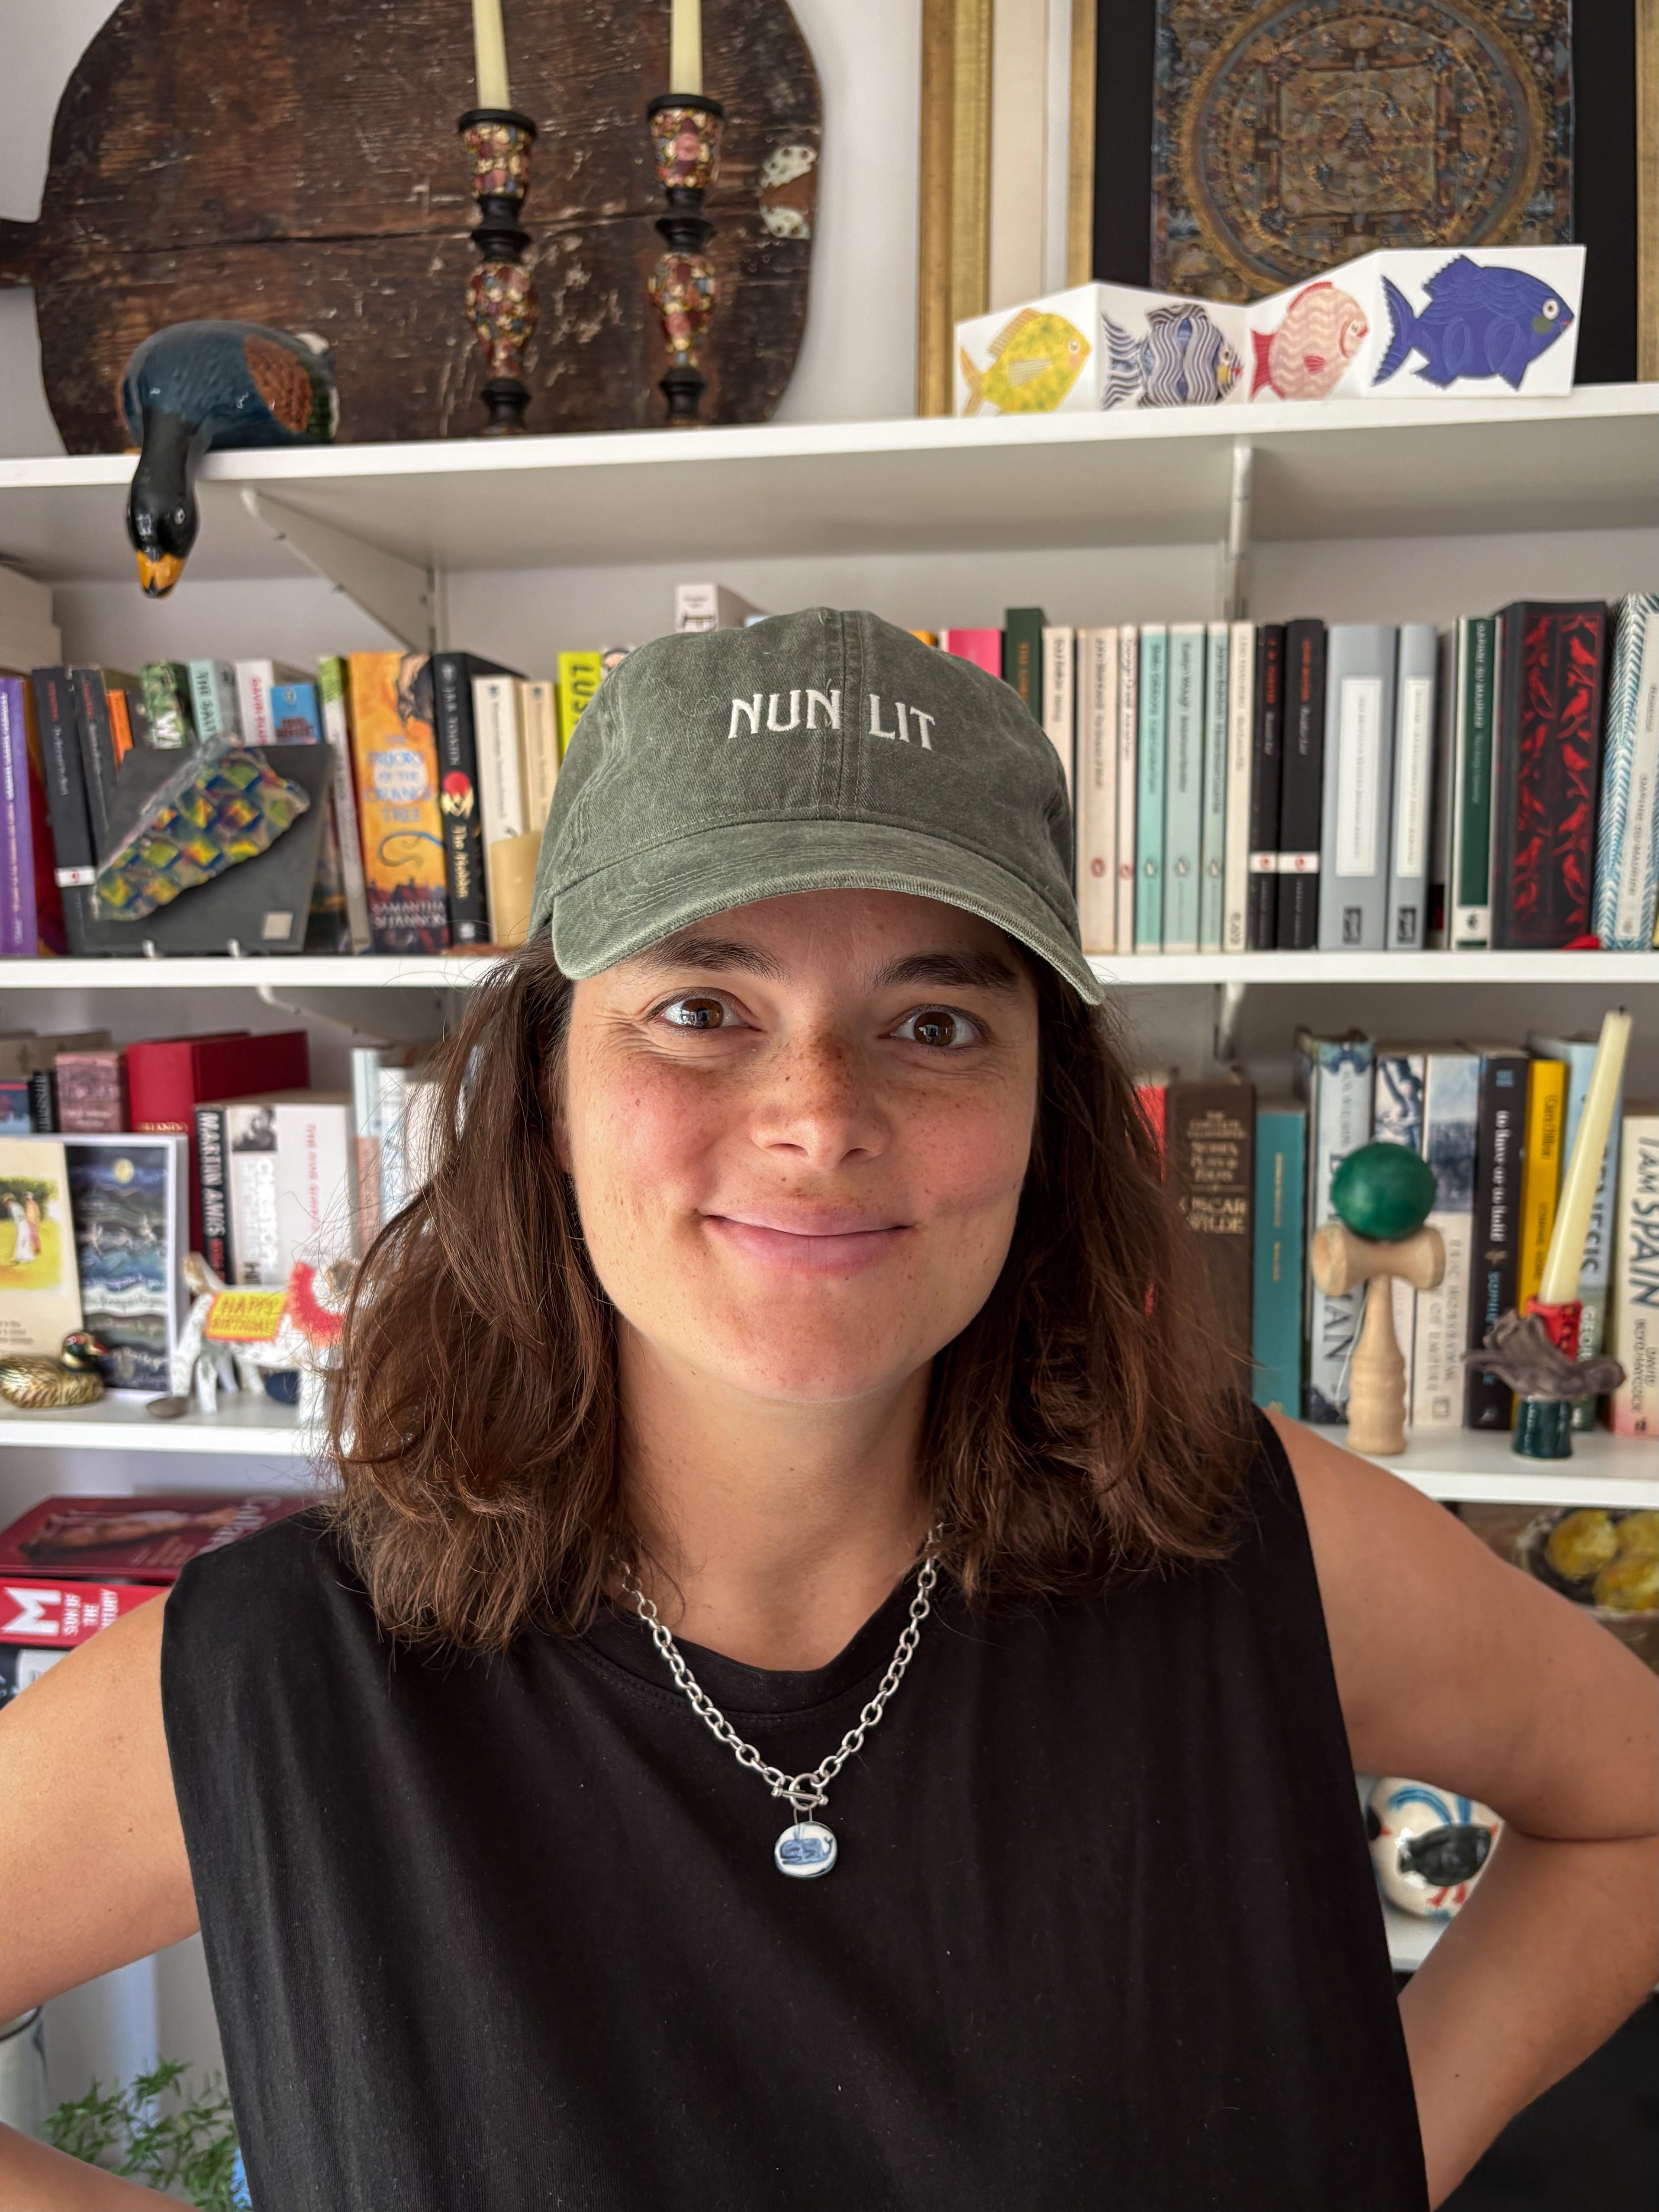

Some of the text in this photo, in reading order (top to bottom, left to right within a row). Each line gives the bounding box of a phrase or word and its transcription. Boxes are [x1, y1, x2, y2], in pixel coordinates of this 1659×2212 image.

[728, 689, 935, 751] NUN LIT
[197, 1111, 223, 1186] MARTIN
[1179, 1195, 1247, 1213] OSCAR
[1629, 1198, 1659, 1310] SPAIN
[1, 1586, 61, 1637] M
